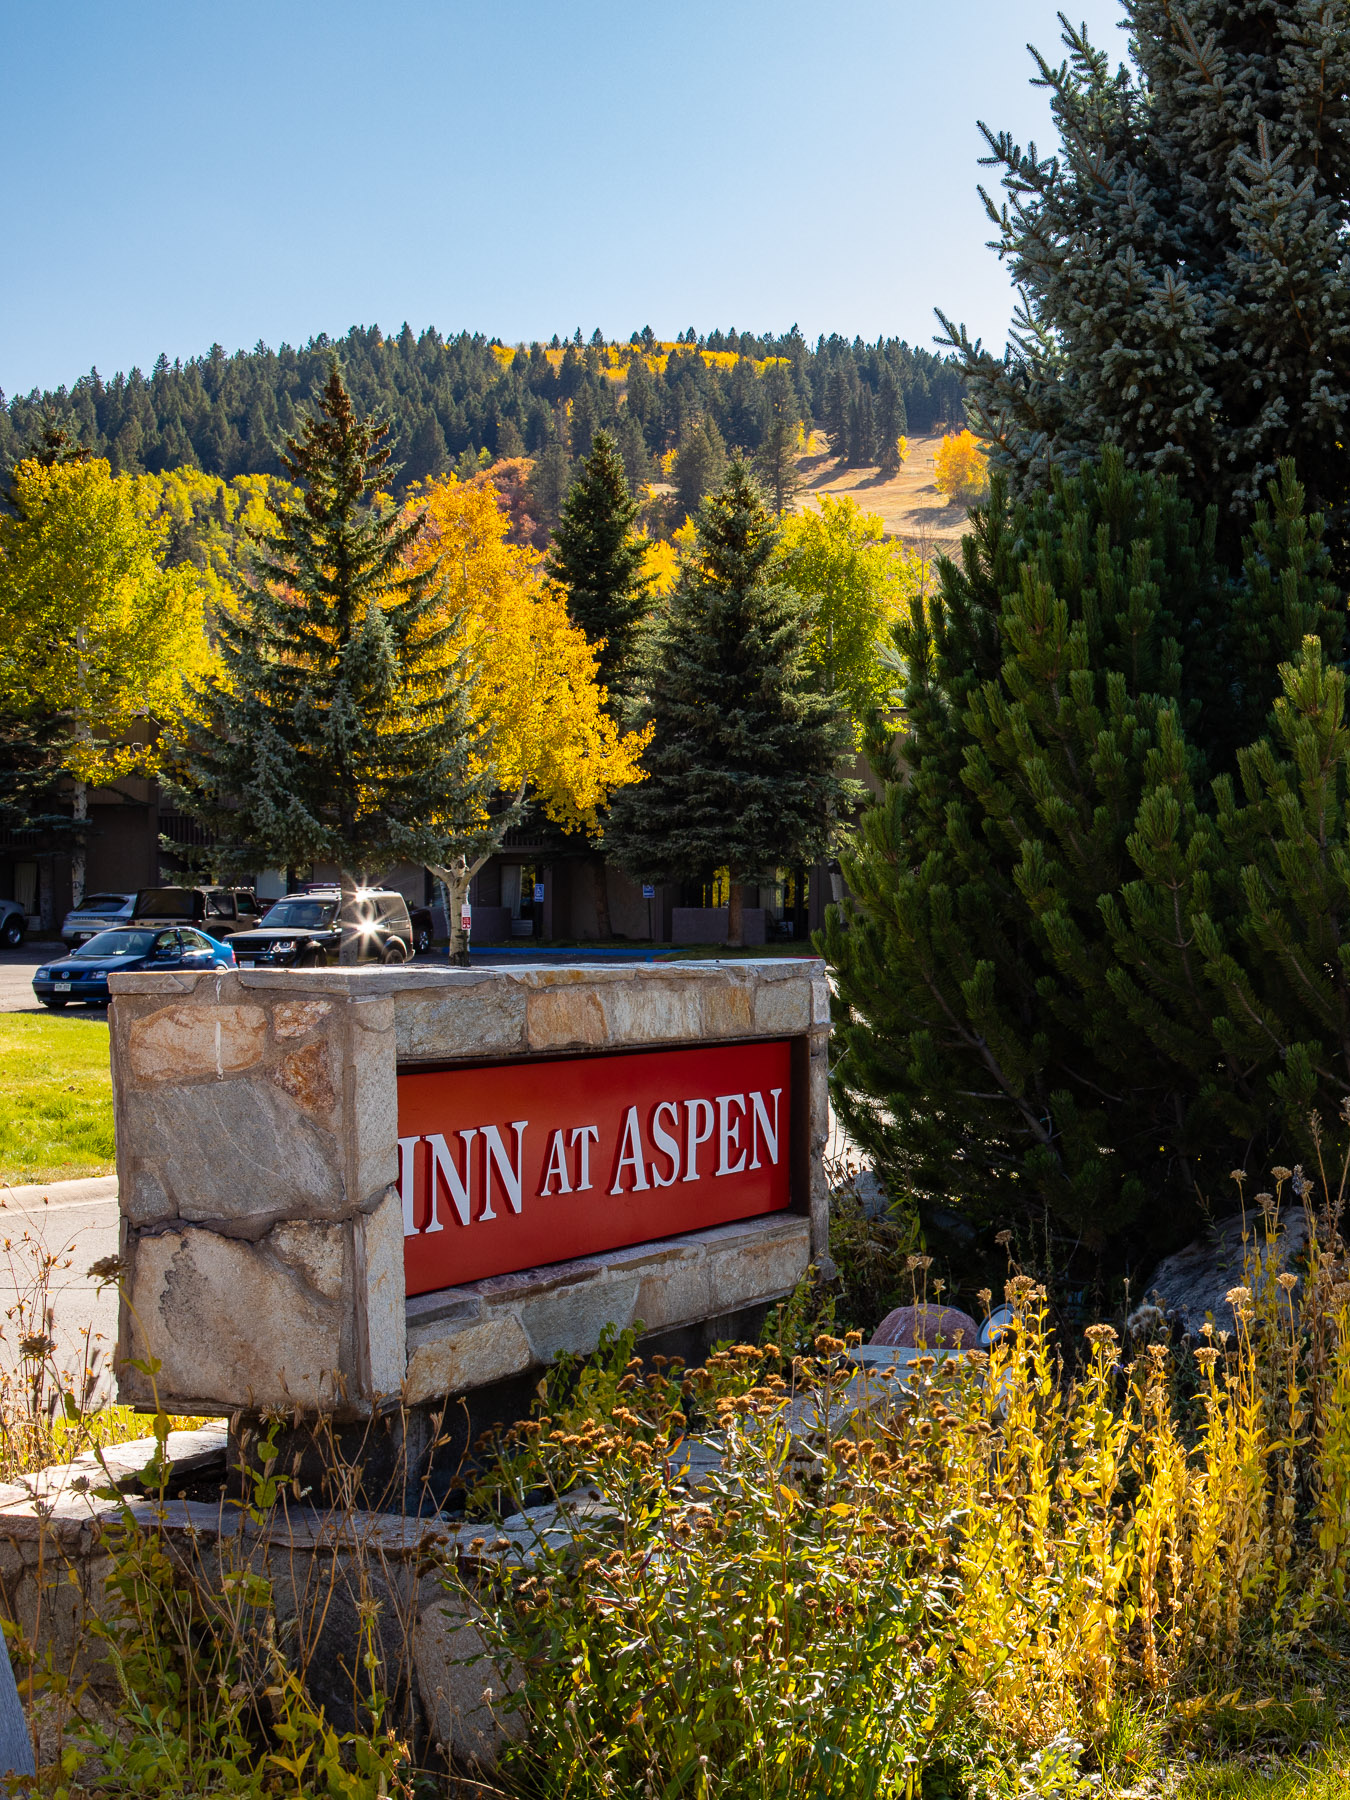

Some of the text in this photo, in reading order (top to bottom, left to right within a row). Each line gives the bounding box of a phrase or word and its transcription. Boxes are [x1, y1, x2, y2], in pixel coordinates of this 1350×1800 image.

[398, 1088, 782, 1236] INN AT ASPEN
